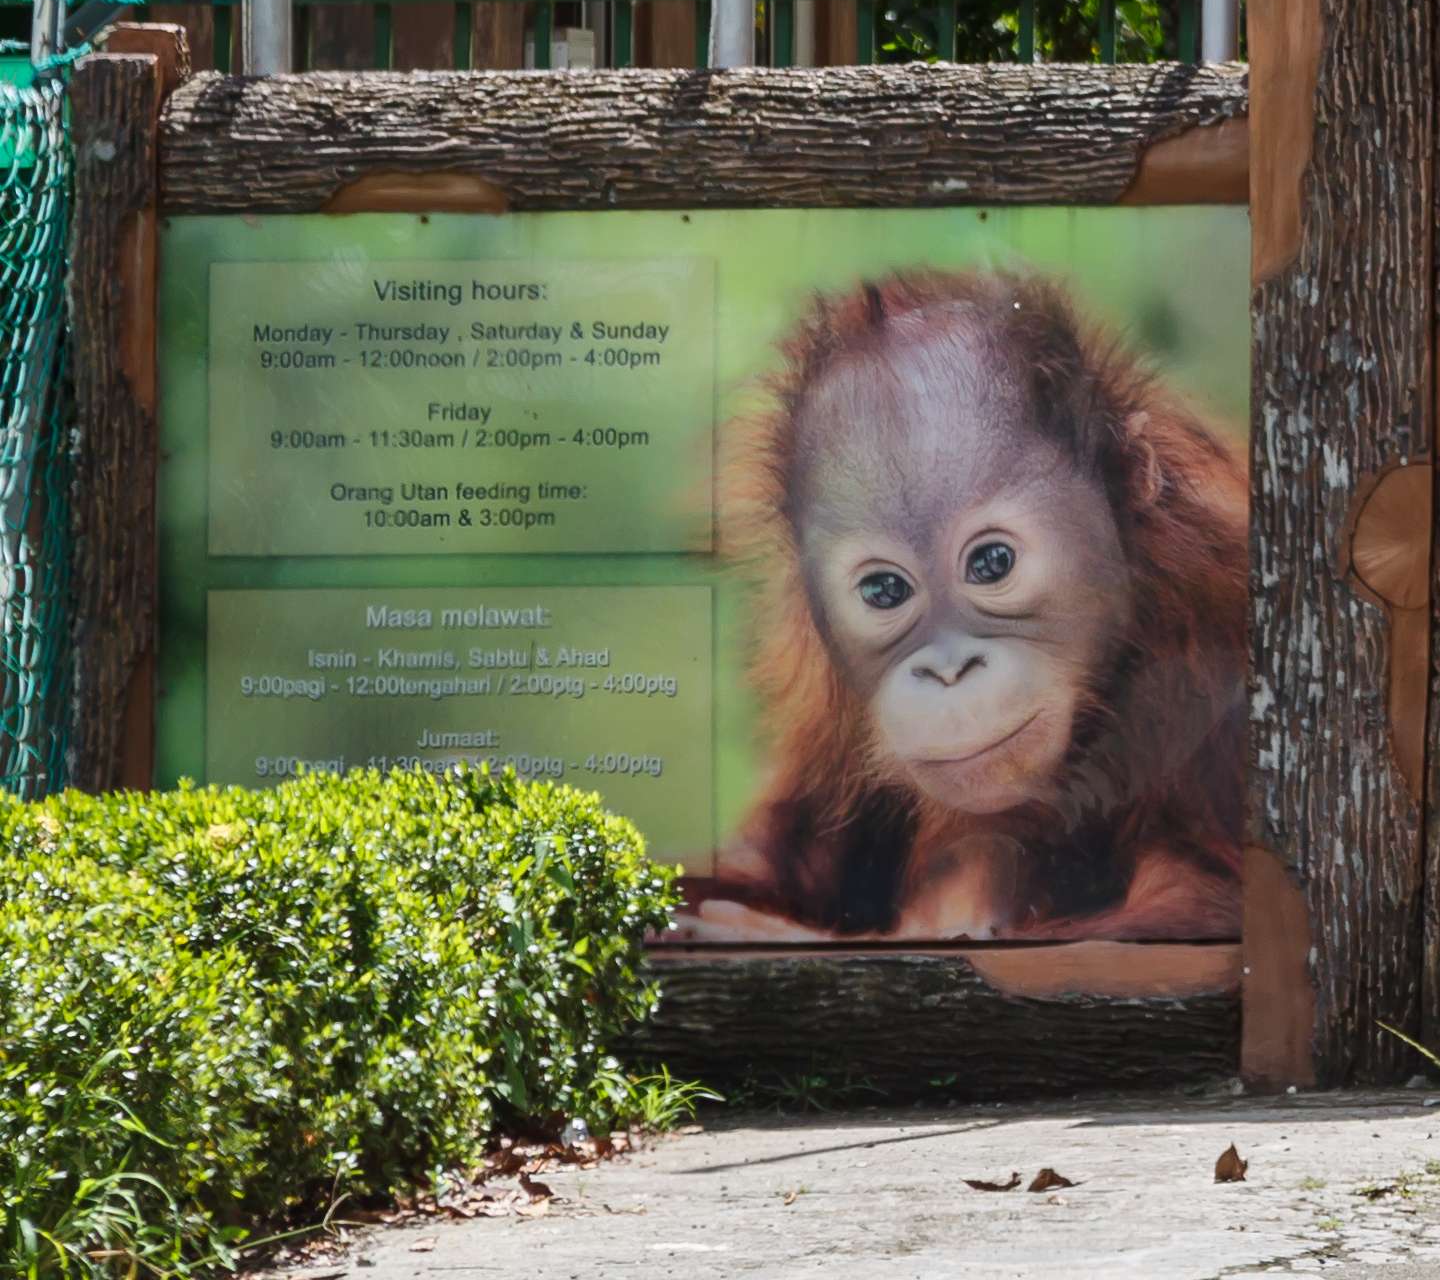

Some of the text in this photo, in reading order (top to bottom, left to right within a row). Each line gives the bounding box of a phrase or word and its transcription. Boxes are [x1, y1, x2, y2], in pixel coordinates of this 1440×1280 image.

[374, 279, 549, 305] Visiting hours:
[253, 324, 333, 345] Monday
[355, 323, 450, 343] Thursday
[470, 322, 562, 343] Saturday
[570, 322, 584, 339] &
[591, 321, 670, 342] Sunday
[260, 351, 335, 370] 9:00am
[359, 351, 465, 369] 12:00noon
[486, 350, 562, 371] 2:00pm
[584, 349, 661, 370] 4:00pm
[427, 403, 492, 424] Friday
[271, 431, 345, 450] 9:00am
[369, 430, 454, 449] 11:30am
[475, 429, 551, 450] 2:00pm
[572, 428, 650, 449] 4:00pm
[330, 482, 588, 505] Orang Utan feeding time:
[363, 509, 556, 530] 10:00am & 3:00pm
[366, 605, 433, 628] Masa
[308, 649, 357, 669] Isnin
[468, 648, 529, 668] Sabtu
[536, 648, 552, 667] &
[555, 647, 610, 667] Ahad
